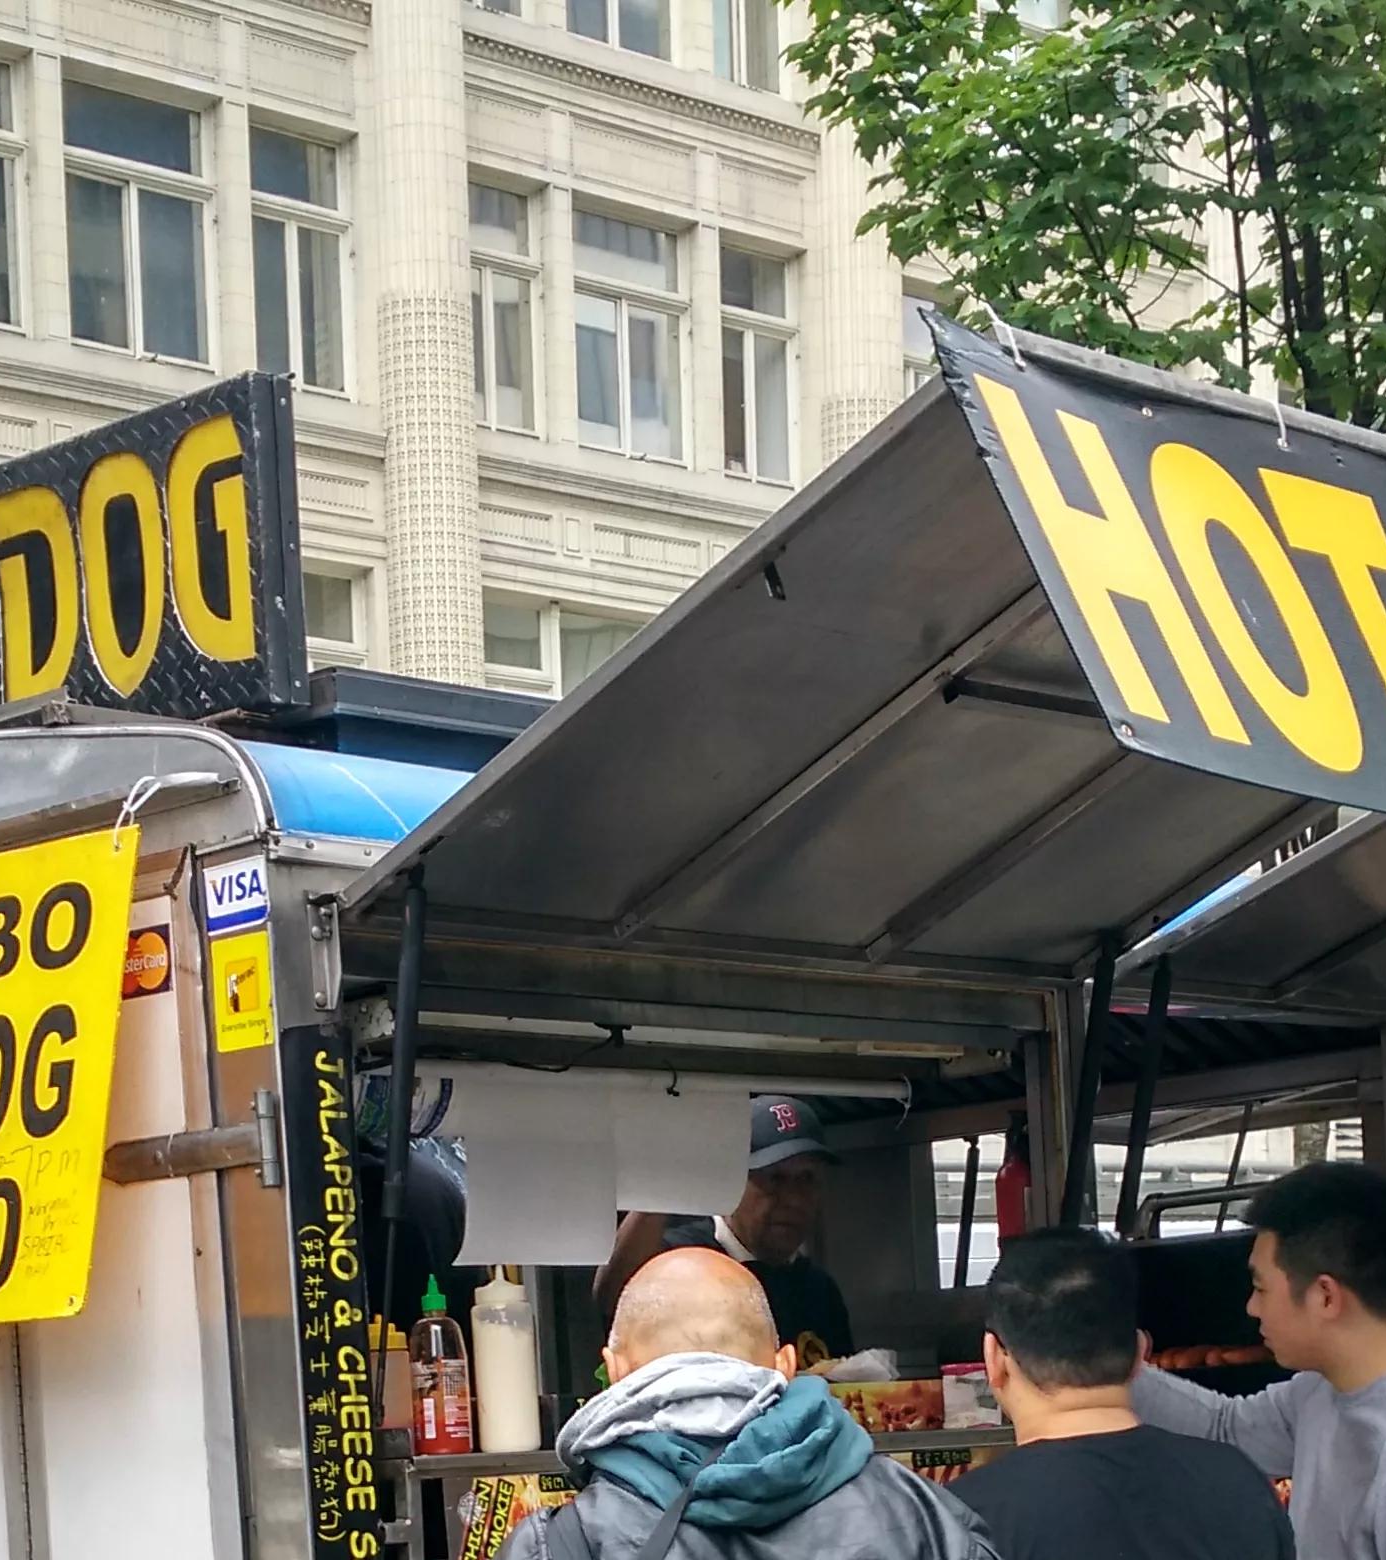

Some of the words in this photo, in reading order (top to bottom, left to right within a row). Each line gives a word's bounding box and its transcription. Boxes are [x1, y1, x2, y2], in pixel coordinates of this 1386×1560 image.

[210, 869, 265, 906] VISA
[125, 952, 166, 974] sterCard
[314, 1051, 358, 1281] JALAPENO
[338, 1345, 376, 1511] CHEESE
[486, 1481, 513, 1560] SMOKIE
